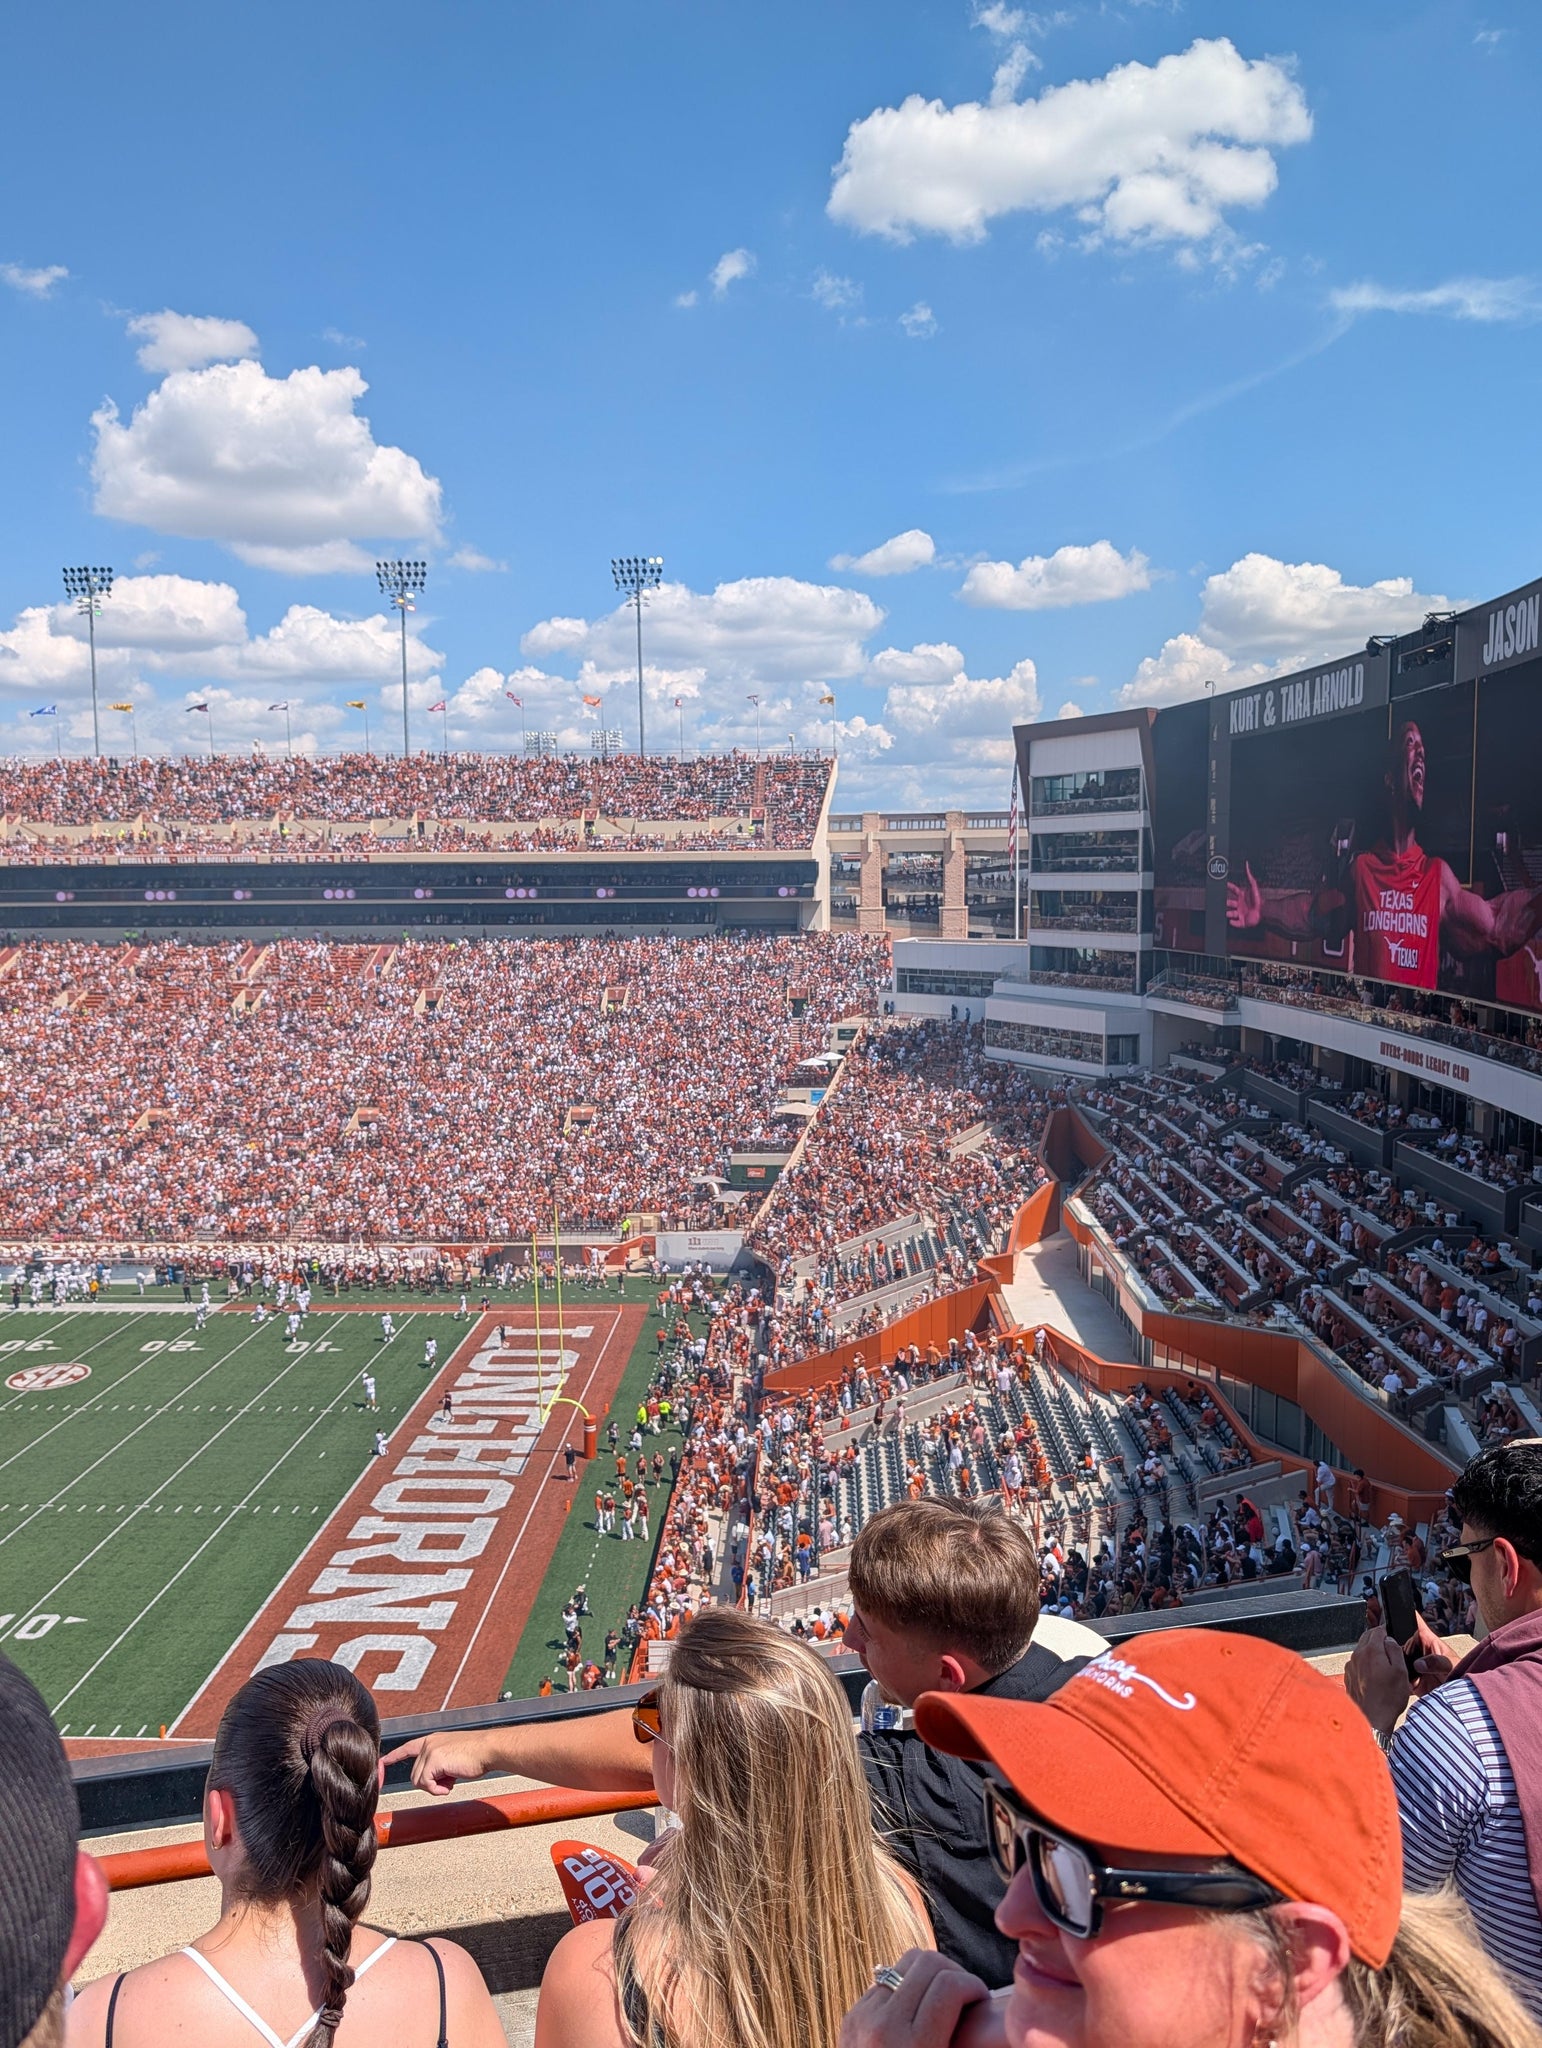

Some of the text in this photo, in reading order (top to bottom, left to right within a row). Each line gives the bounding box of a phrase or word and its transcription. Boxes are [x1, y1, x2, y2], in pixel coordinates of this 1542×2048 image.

[1483, 594, 1540, 666] JASON
[1229, 663, 1364, 734] KURT & TARA ARNOLD
[1210, 860, 1226, 873] ufcu
[1380, 890, 1413, 910] TEXAS
[1363, 910, 1428, 938] LONGHORNS
[1397, 947, 1418, 968] TEXAS!
[1425, 1055, 1450, 1076] LEGACY
[140, 1340, 197, 1351] 20
[284, 1341, 334, 1353] 10
[11, 1364, 86, 1389] SEC
[250, 1325, 594, 1691] LONGHORNS
[1076, 1666, 1135, 1698] HORNS
[581, 1848, 637, 1906] CLUB
